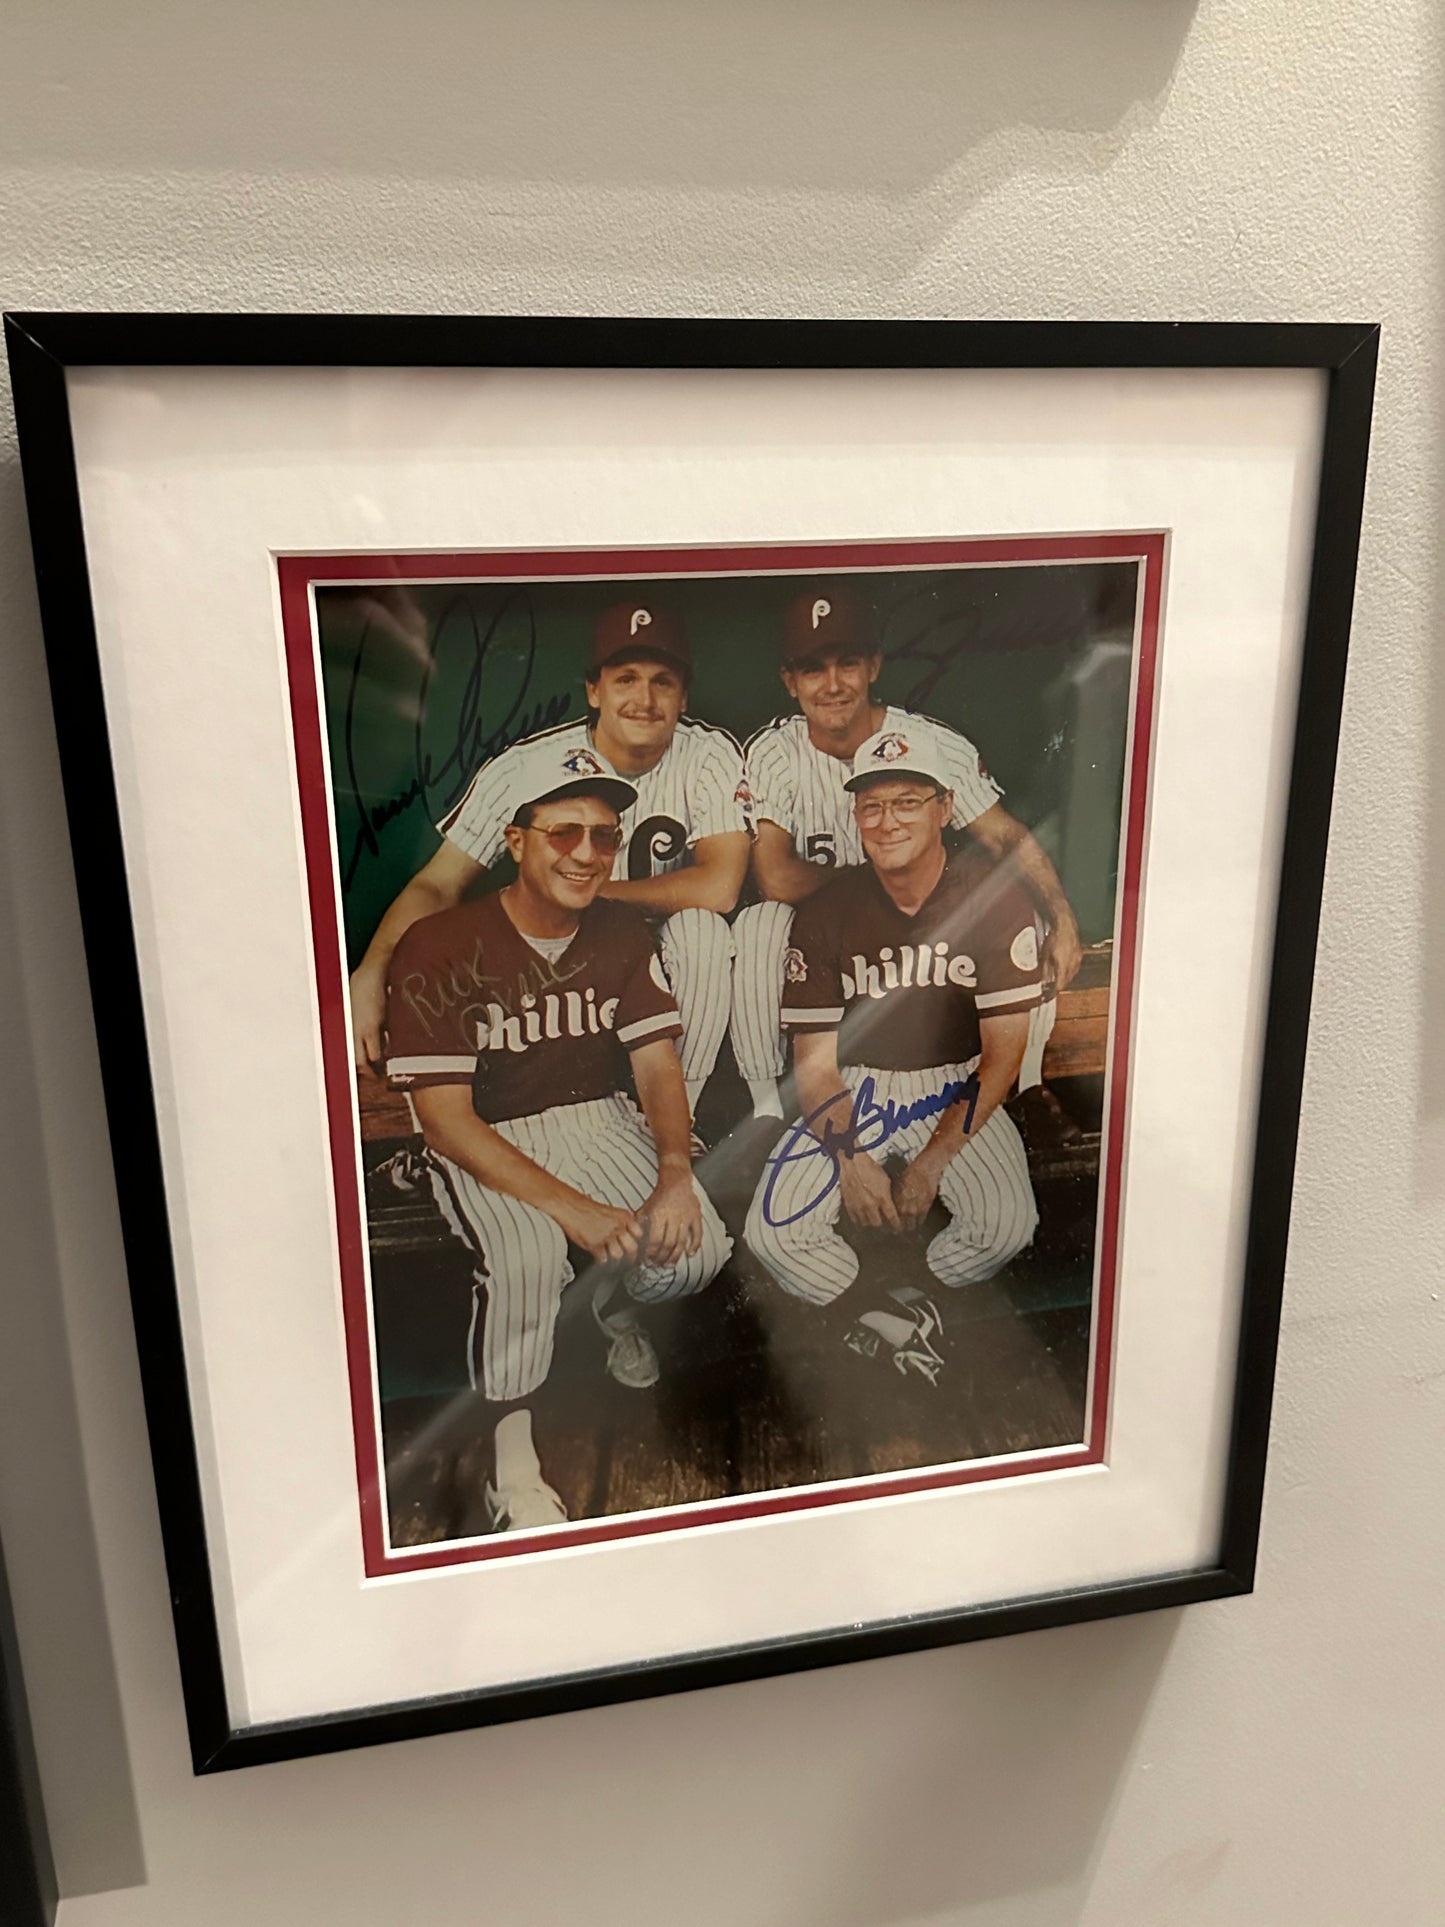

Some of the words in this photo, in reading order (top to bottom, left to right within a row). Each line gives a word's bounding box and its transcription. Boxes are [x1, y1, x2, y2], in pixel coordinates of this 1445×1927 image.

[630, 608, 652, 636] P
[812, 599, 832, 629] P
[628, 815, 687, 881] P
